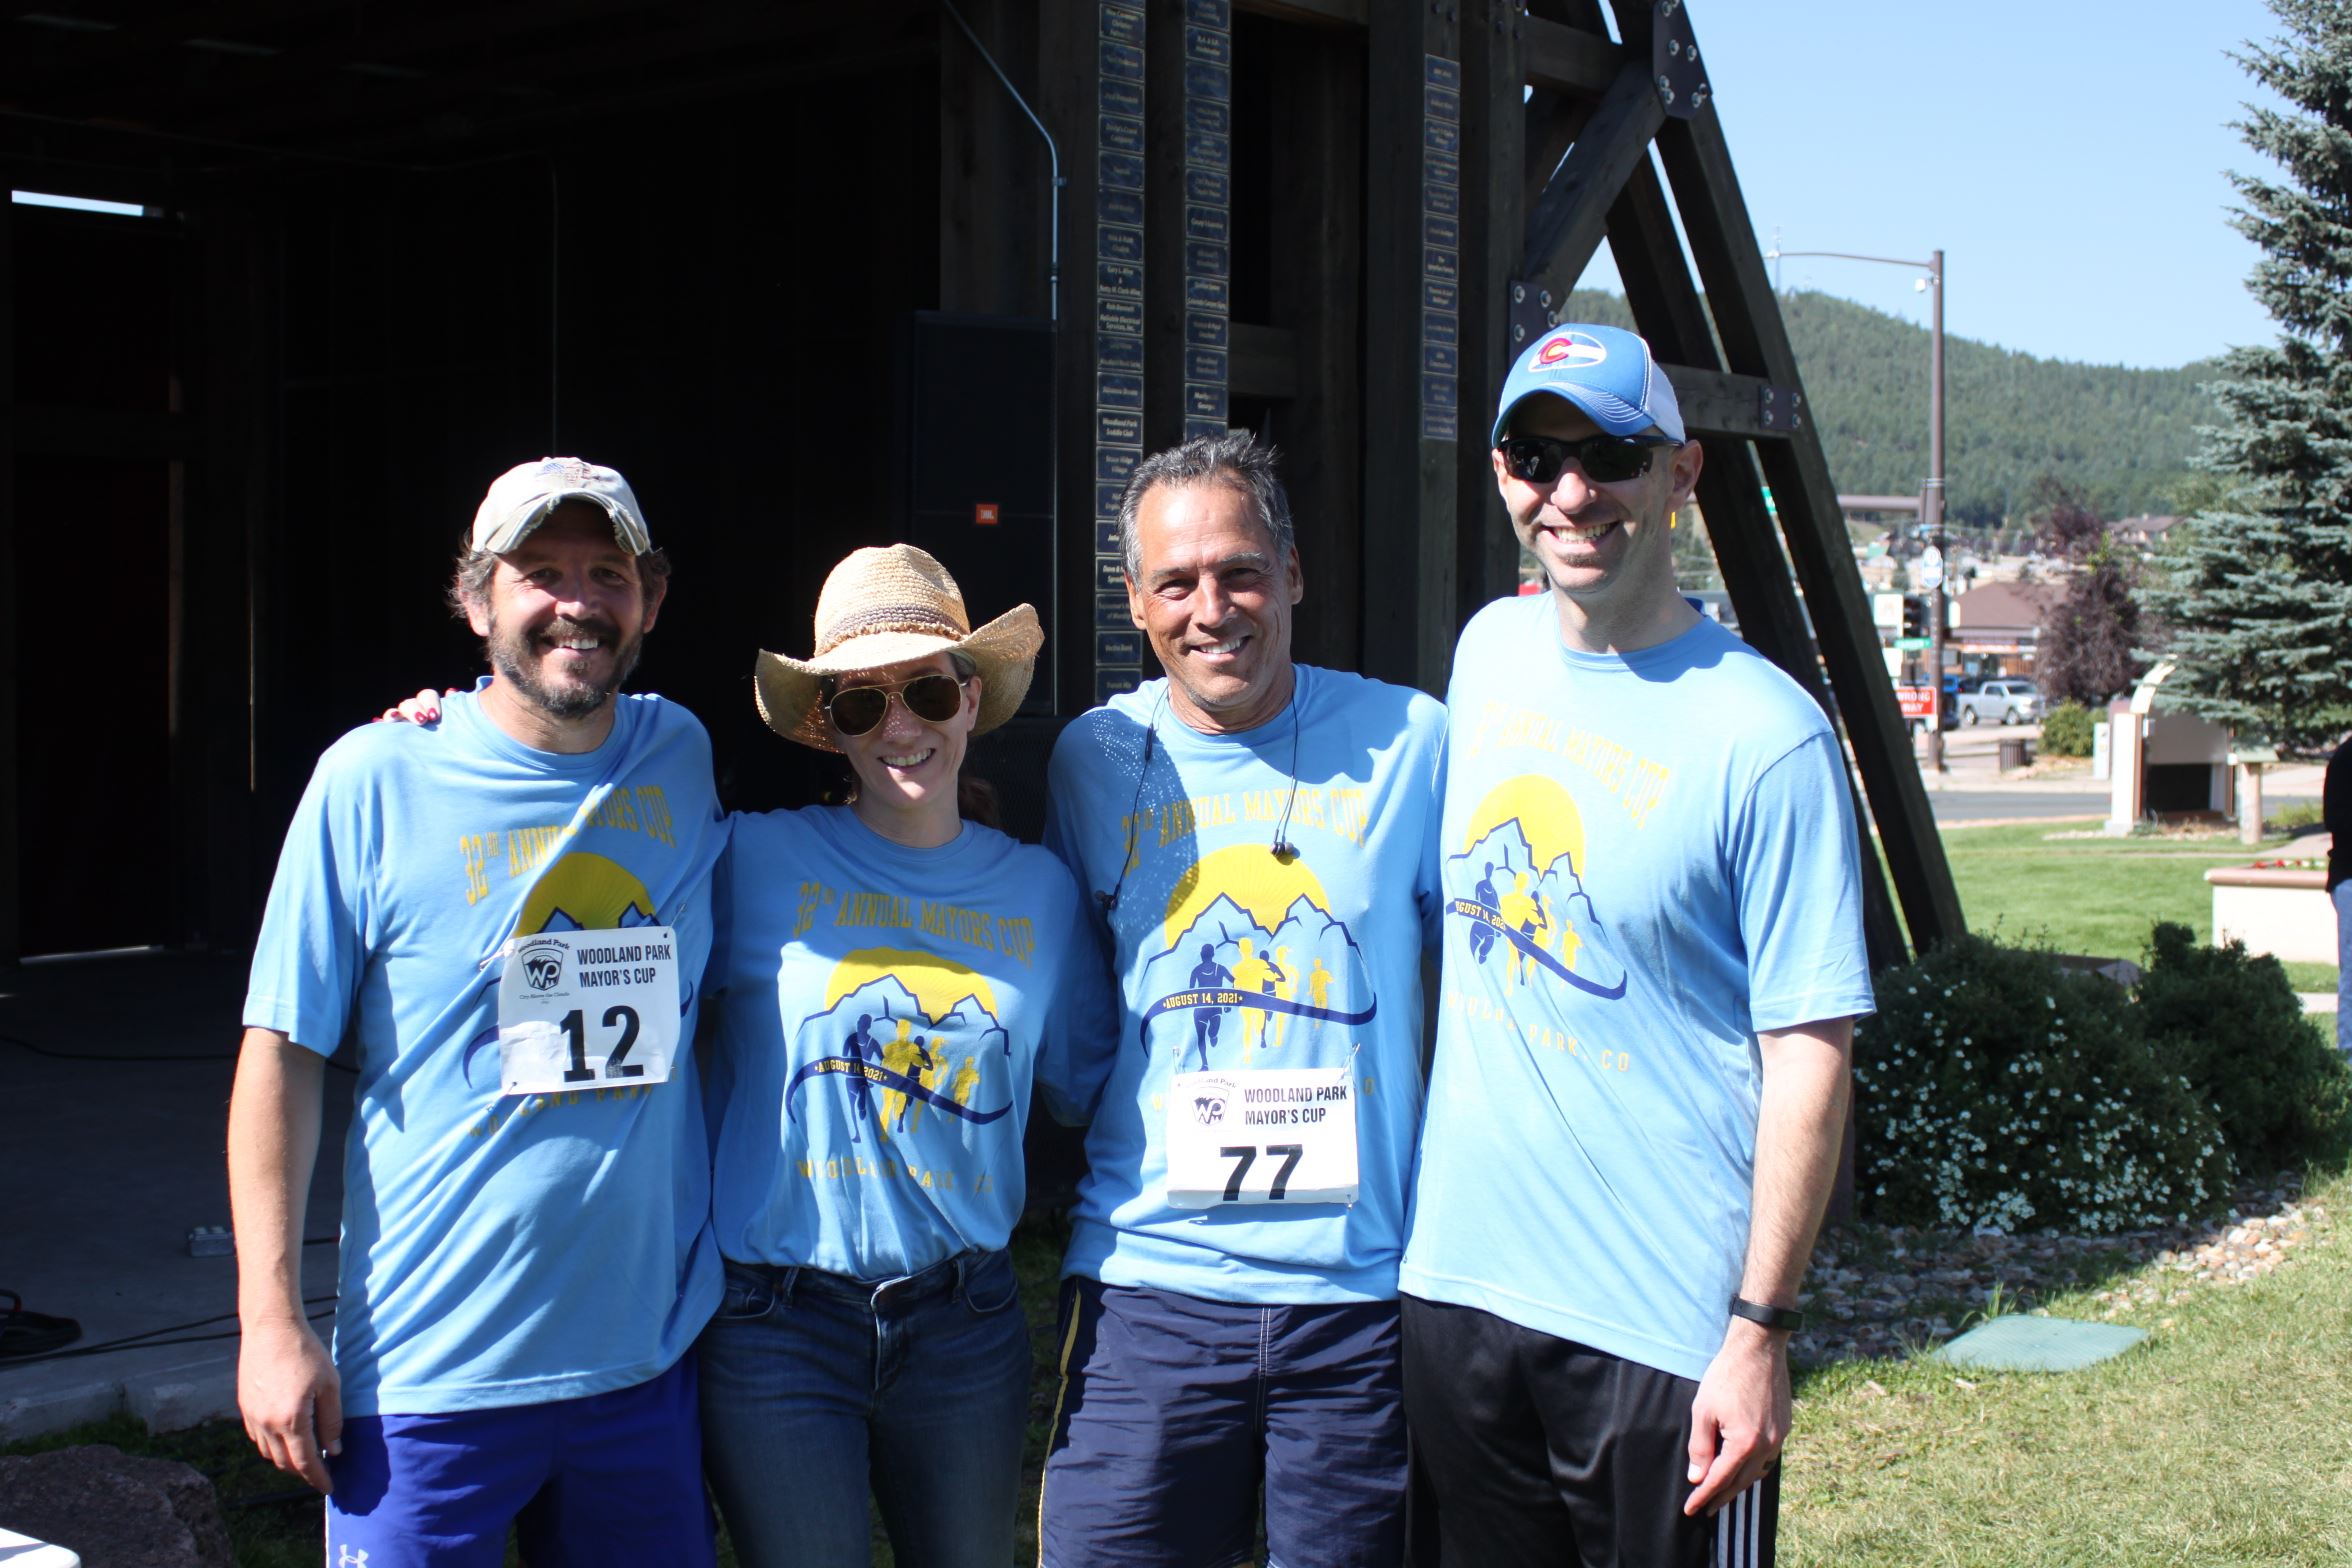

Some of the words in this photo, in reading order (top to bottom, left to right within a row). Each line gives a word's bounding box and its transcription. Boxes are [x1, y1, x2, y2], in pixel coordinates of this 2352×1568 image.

[1329, 787, 1369, 849] CUP
[834, 892, 913, 929] ANNUAL
[918, 898, 995, 951] MAYORS
[997, 916, 1035, 970] CUP
[577, 946, 642, 966] WOODLAND
[645, 944, 672, 961] PARK
[579, 969, 632, 988] MAYOR'S
[634, 967, 656, 984] CUP
[1166, 993, 1199, 1009] AUGUST
[1202, 992, 1214, 1005] 14,
[1217, 992, 1238, 1004] 2021
[559, 1005, 645, 1083] 12
[817, 1059, 851, 1073] AUGUST
[863, 1066, 884, 1082] 2021
[1600, 1049, 1630, 1072] CO
[1244, 1087, 1313, 1104] WOODLAND
[1315, 1085, 1348, 1102] PARK
[1245, 1107, 1299, 1126] MAYOR'S
[1302, 1106, 1327, 1124] CUP
[1219, 1143, 1304, 1202] 77
